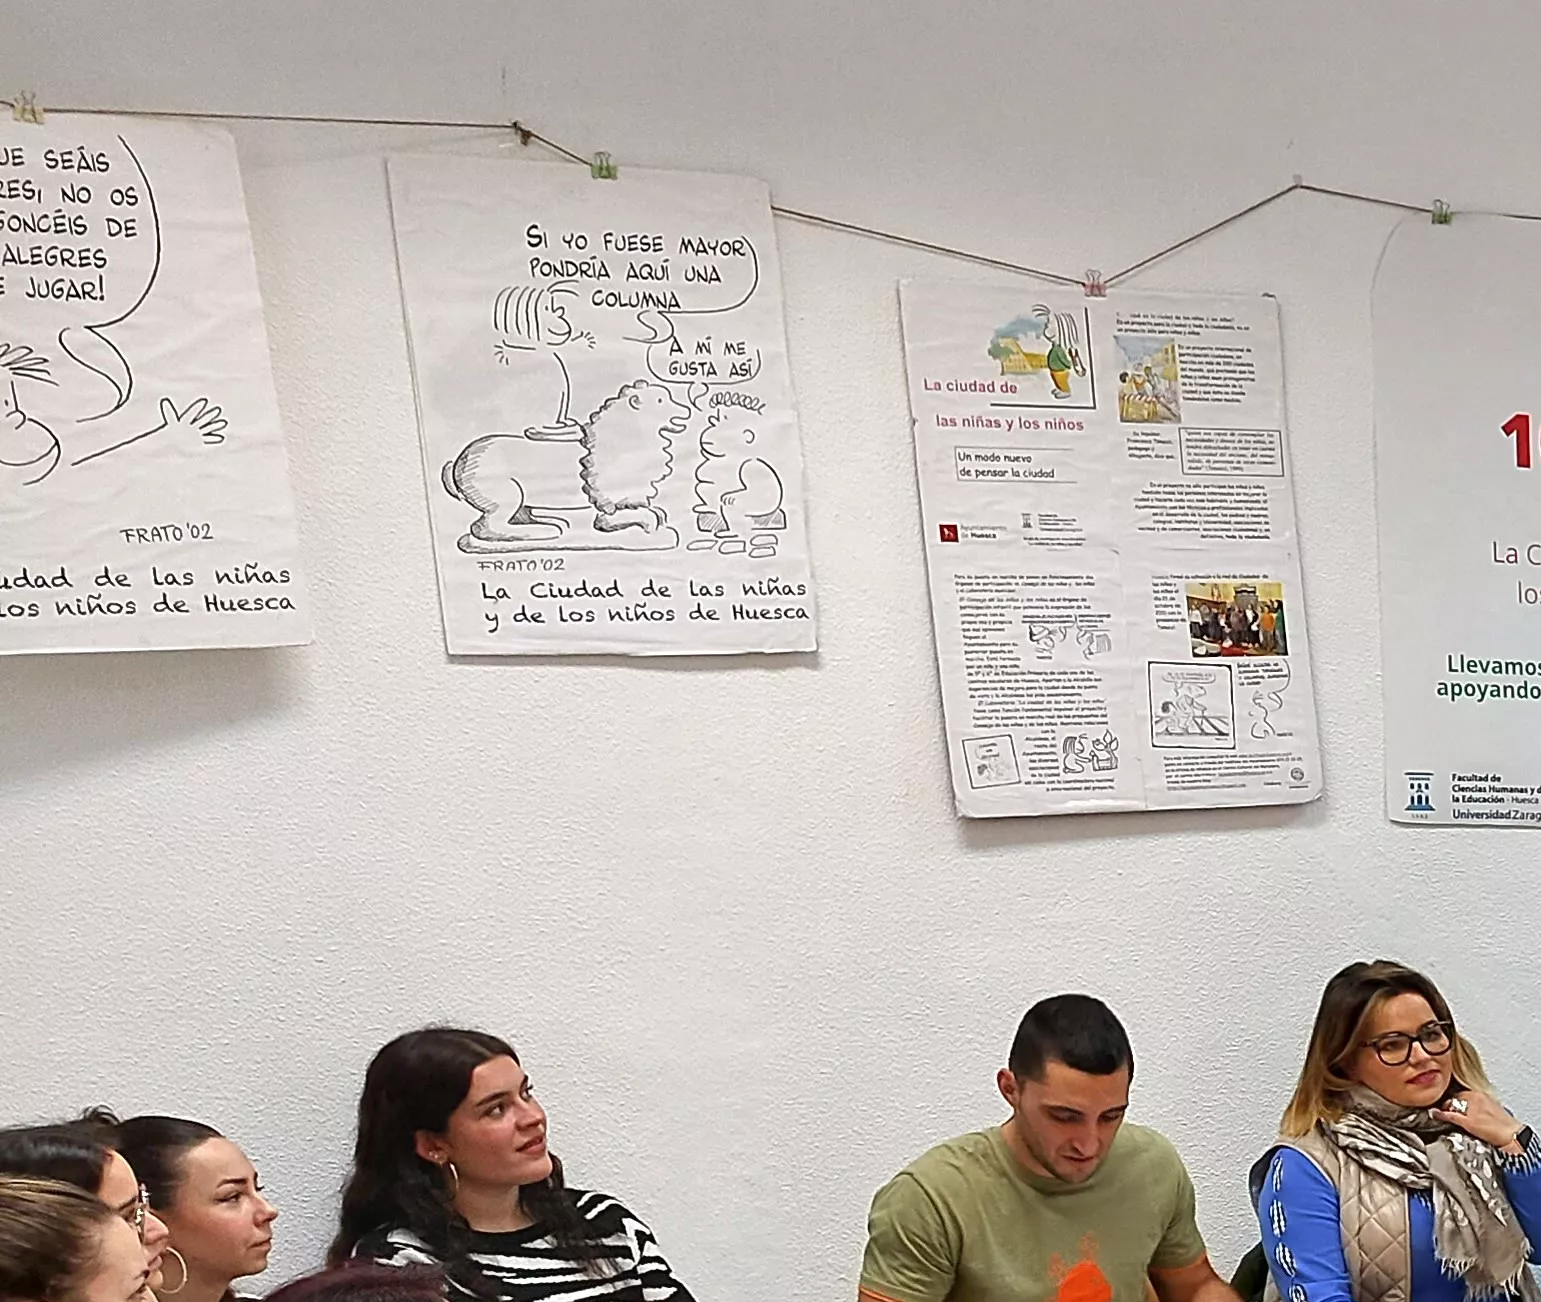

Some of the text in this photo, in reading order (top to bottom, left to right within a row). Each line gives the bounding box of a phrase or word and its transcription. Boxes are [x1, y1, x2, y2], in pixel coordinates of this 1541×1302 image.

[44, 146, 110, 173] SEÁIS
[61, 184, 138, 206] NO OS
[106, 218, 137, 237] DE
[562, 234, 588, 250] YO
[603, 232, 664, 252] FUESE
[679, 237, 747, 256] MAYOR
[2, 243, 107, 268] ALEGRES
[529, 256, 722, 284] PONDRÍA AQUÍ UNA
[26, 275, 104, 301] JUGAR!
[592, 290, 682, 309] COLUMNA
[669, 337, 746, 357] A MÍ ME
[669, 359, 753, 377] GUSTA ASÍ
[924, 378, 1018, 394] La ciudad de
[936, 414, 1085, 432] las niñas y los niños
[958, 451, 1032, 464] Un modo nuevo
[959, 466, 1055, 479] de pensar la ciudad
[1492, 541, 1519, 565] La
[94, 562, 291, 588] de las niñas
[481, 577, 807, 601] La Ciudad de las niñas
[56, 593, 296, 616] niños de Huesca
[485, 603, 810, 633] y de los niños de Huesca
[1436, 681, 1541, 704] apoyando
[1452, 773, 1502, 784] Facultad de
[1452, 784, 1488, 795] Ciencias
[1489, 786, 1528, 795] Humanas
[1452, 794, 1540, 806] la Educación Huesca
